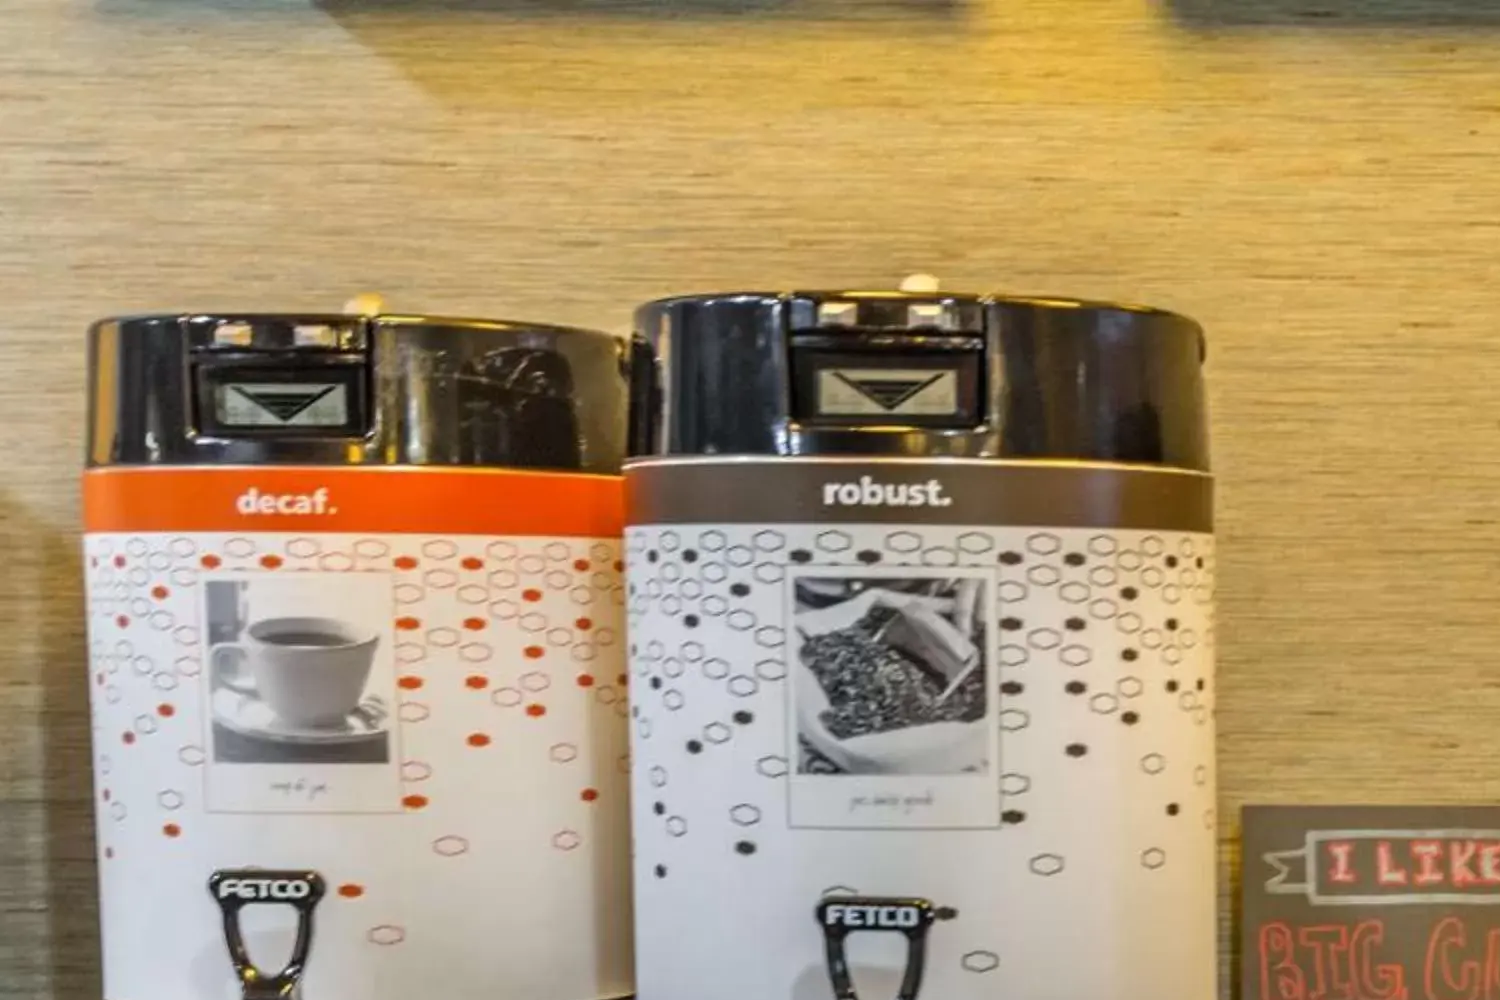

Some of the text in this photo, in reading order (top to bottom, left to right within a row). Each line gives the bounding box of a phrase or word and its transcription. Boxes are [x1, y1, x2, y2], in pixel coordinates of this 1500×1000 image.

[236, 486, 338, 515] decaf.
[823, 475, 953, 506] robust.
[1328, 842, 1355, 883] I
[219, 879, 310, 899] FETCO
[825, 905, 919, 927] FETCO
